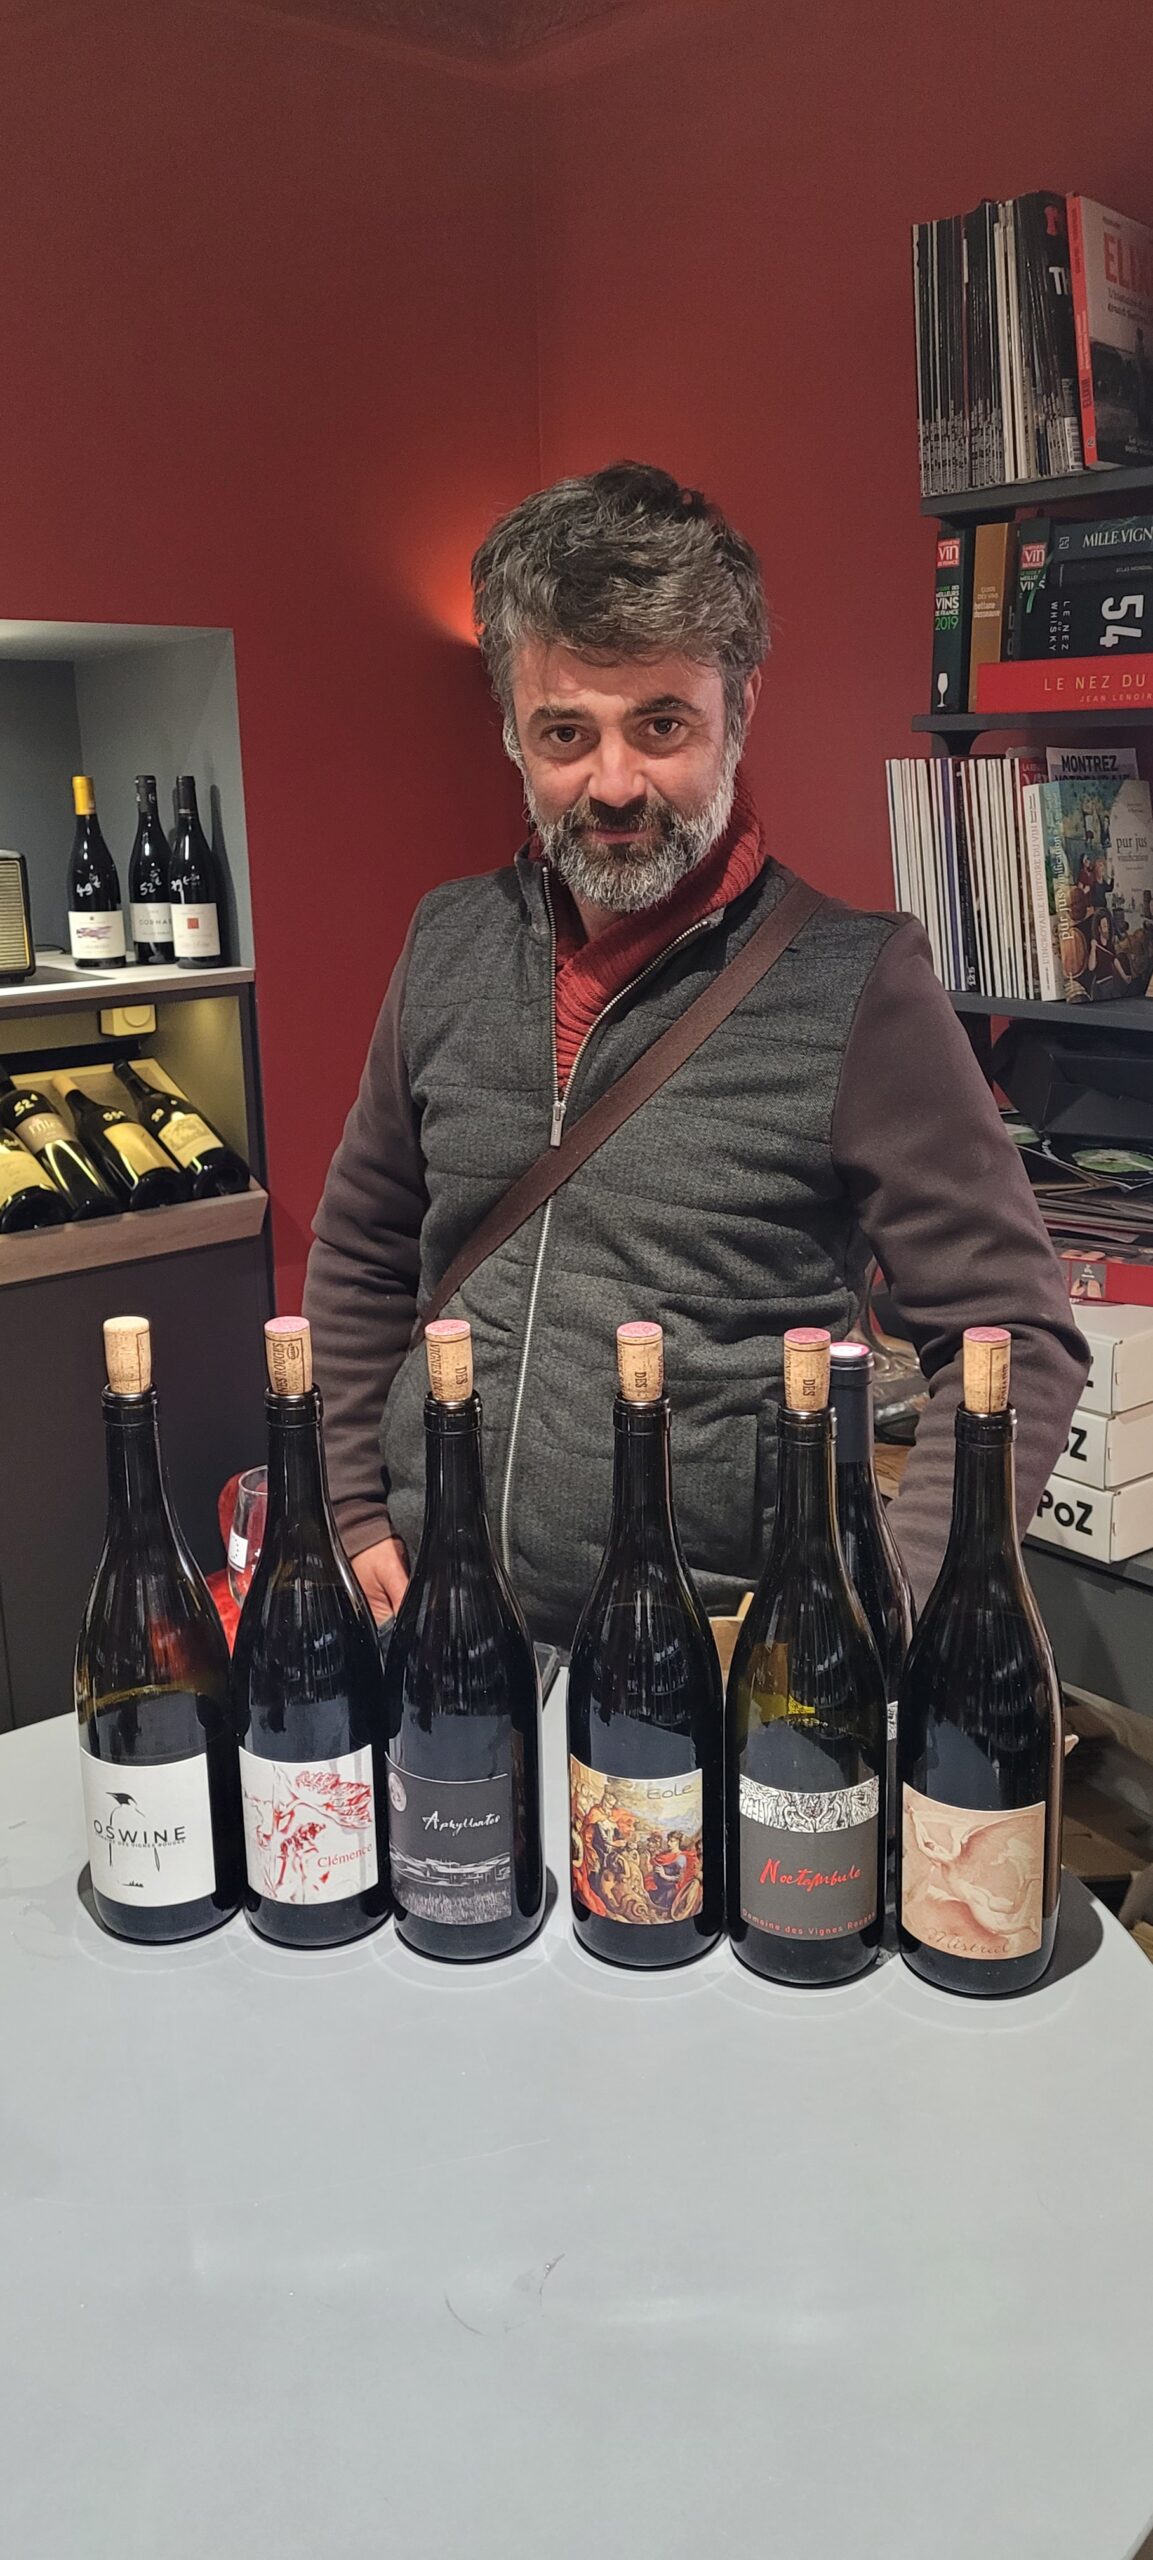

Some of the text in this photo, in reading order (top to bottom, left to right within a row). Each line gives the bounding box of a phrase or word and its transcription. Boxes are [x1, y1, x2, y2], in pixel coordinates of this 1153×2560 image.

[1082, 530, 1120, 548] MILLE
[936, 596, 960, 610] VINS
[935, 615, 959, 630] 2019
[1048, 601, 1059, 651] WHISKY
[1099, 594, 1144, 648] 54
[1061, 624, 1070, 650] NEZ
[1044, 673, 1146, 691] LE NEZ DU
[1080, 695, 1107, 703] JEAN
[1061, 754, 1119, 773] MONTREZ
[1116, 832, 1148, 854] pur jus
[1058, 890, 1072, 912] jus
[1060, 916, 1075, 940] pur
[272, 1342, 287, 1377] ROUGES
[455, 1365, 469, 1386] DES
[634, 1371, 648, 1389] DES
[802, 1378, 816, 1397] DES
[93, 1819, 187, 1844] OSWINE
[317, 1843, 373, 1868] Clémence
[760, 1858, 863, 1893] Noctambule
[741, 1907, 781, 1932] Domaine
[784, 1926, 804, 1936] des
[808, 1926, 844, 1937] Vignes
